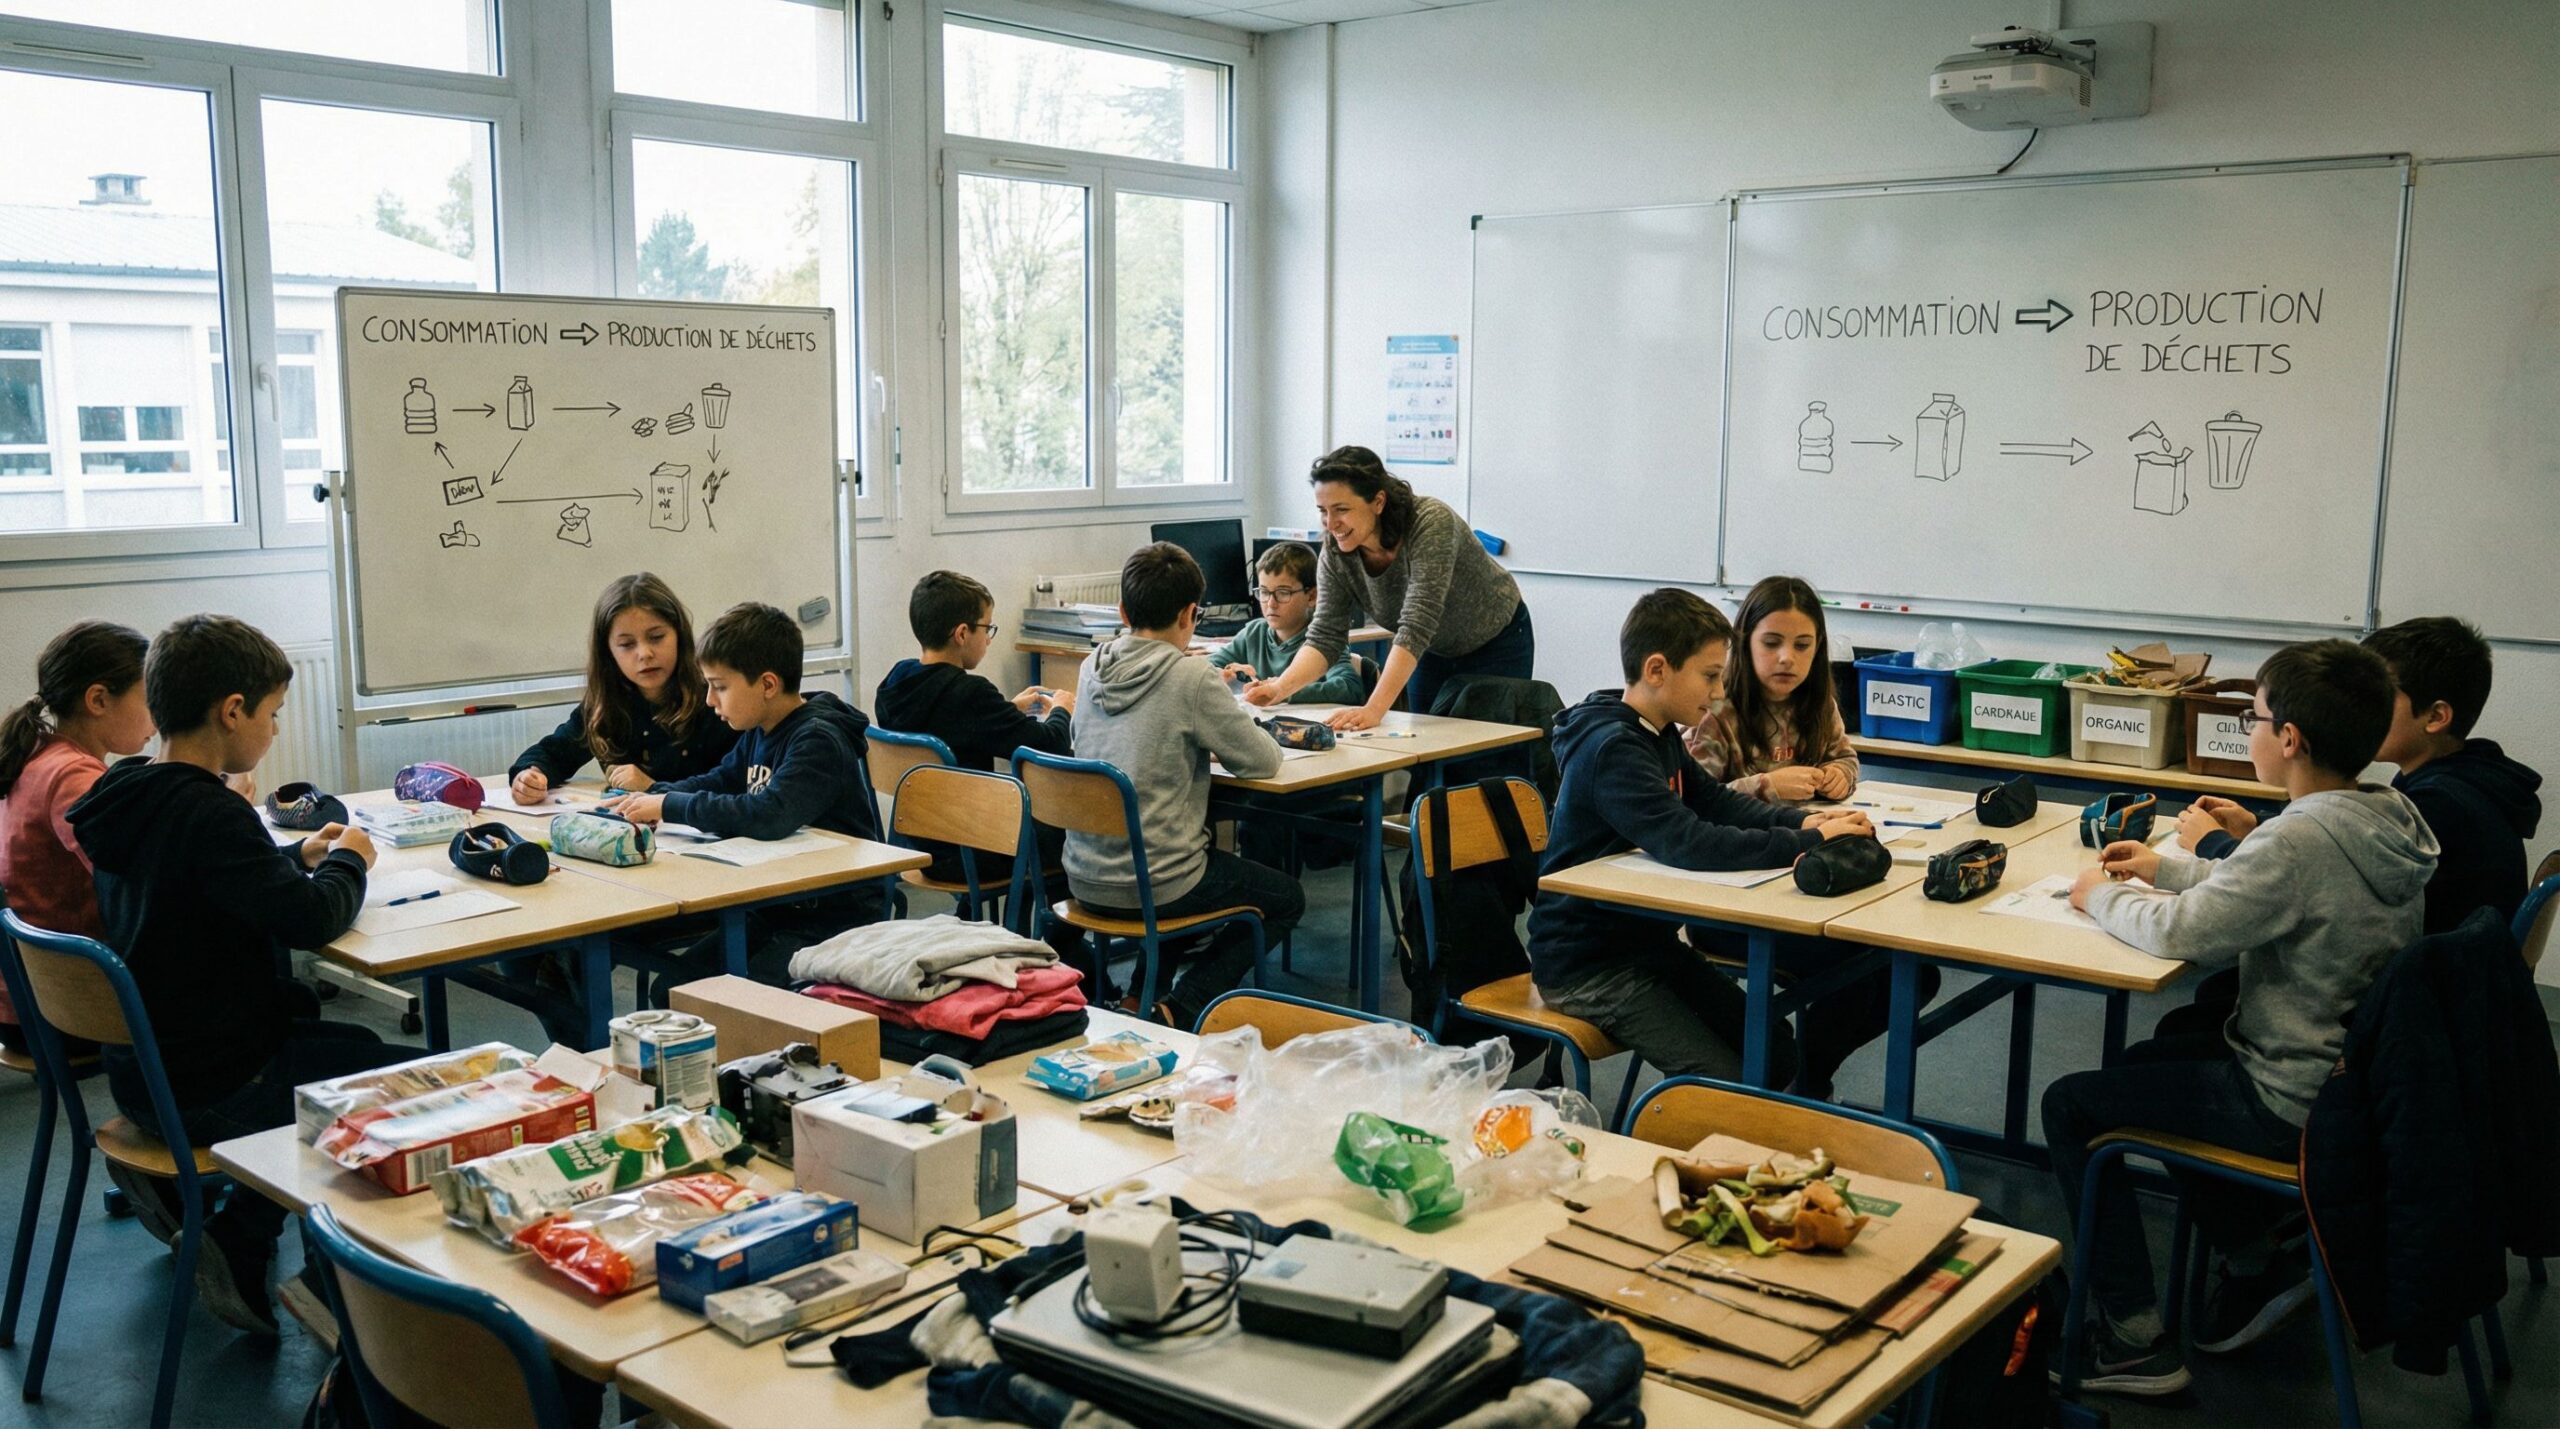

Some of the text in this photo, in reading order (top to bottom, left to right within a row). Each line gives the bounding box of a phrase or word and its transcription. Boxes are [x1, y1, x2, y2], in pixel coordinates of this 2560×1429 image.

[719, 327, 741, 351] DE
[745, 323, 818, 352] DÉCHETS
[2084, 334, 2293, 376] DE DÉCHETS
[1871, 691, 1926, 711] PLASTIC
[2085, 715, 2146, 735] ORGANIC
